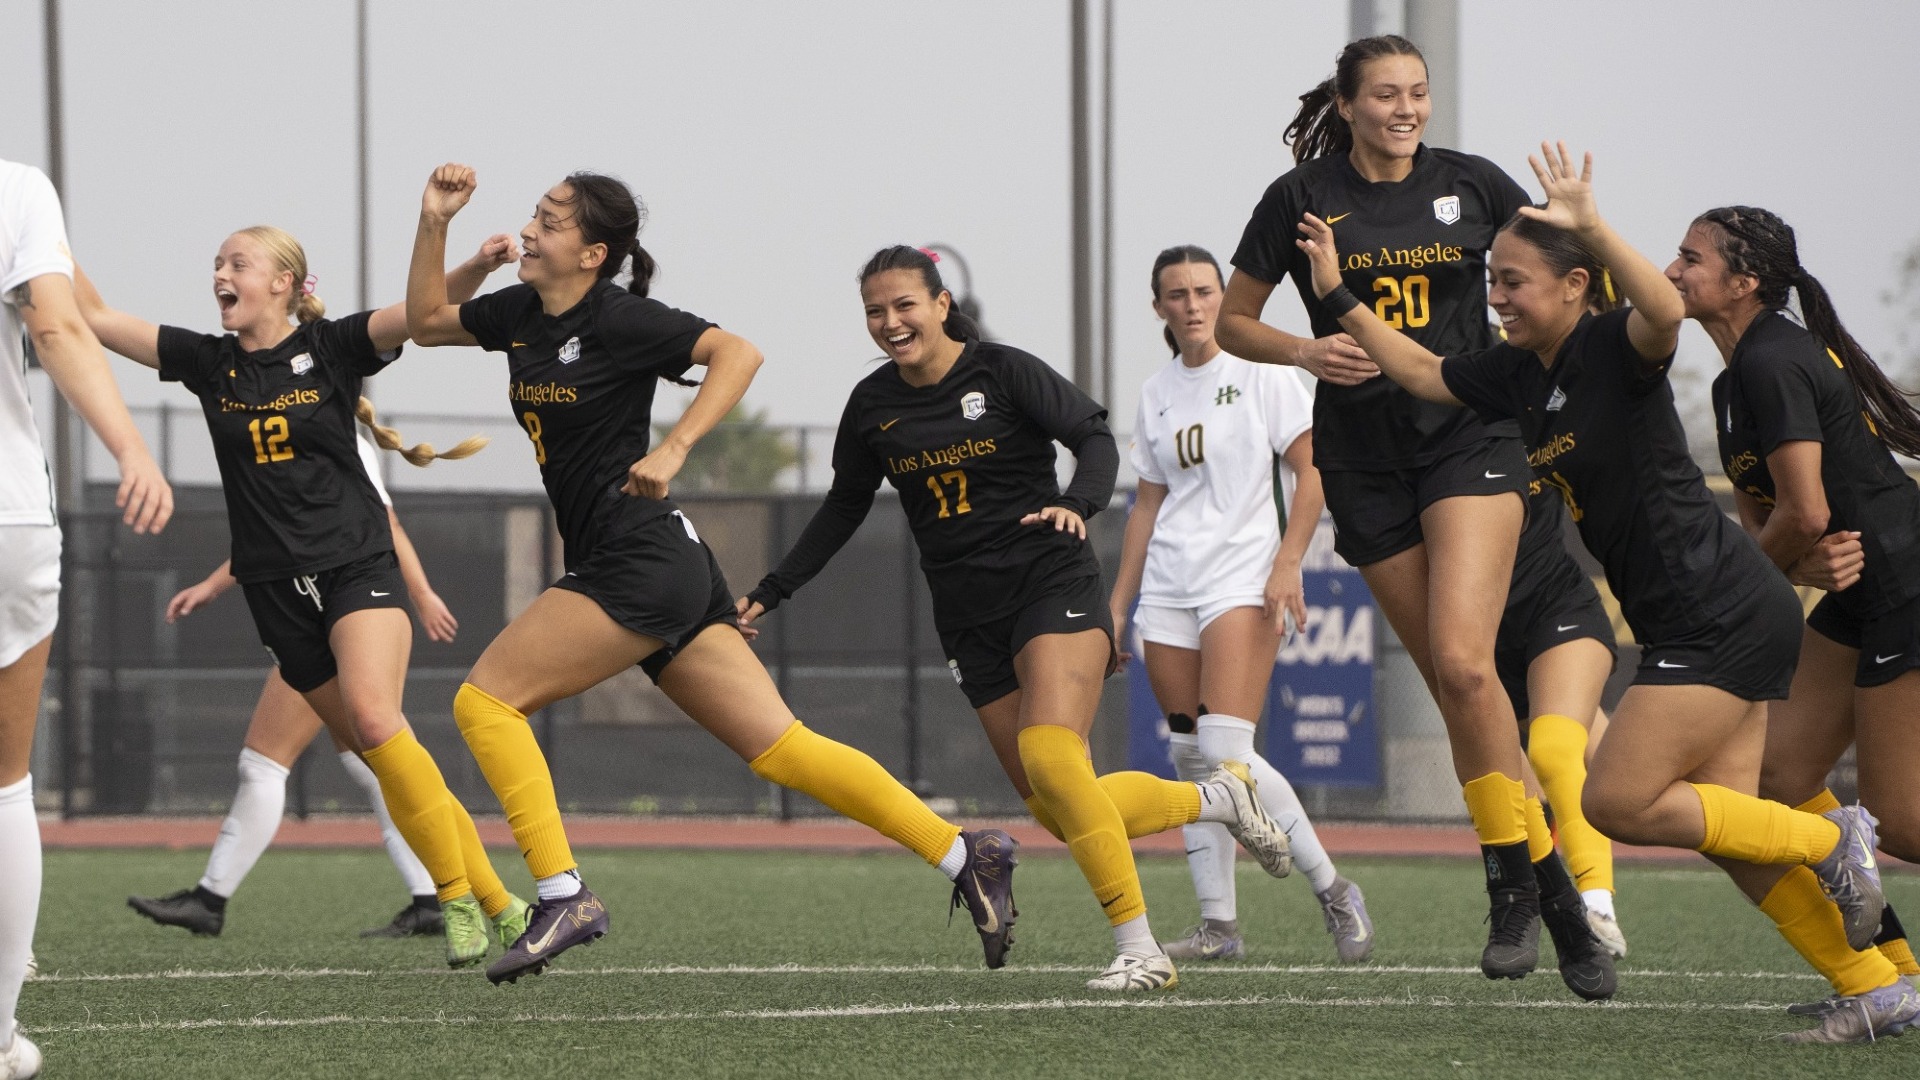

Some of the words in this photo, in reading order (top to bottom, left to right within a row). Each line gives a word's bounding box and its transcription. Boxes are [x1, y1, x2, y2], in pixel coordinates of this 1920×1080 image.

[1377, 242, 1463, 268] Angeles
[1372, 274, 1430, 330] 20
[250, 389, 320, 411] geles
[515, 381, 578, 406] Angeles
[248, 415, 294, 464] 12
[888, 455, 918, 474] Los
[921, 438, 997, 469] Angeles
[1176, 423, 1204, 469] 10
[926, 469, 972, 519] 17
